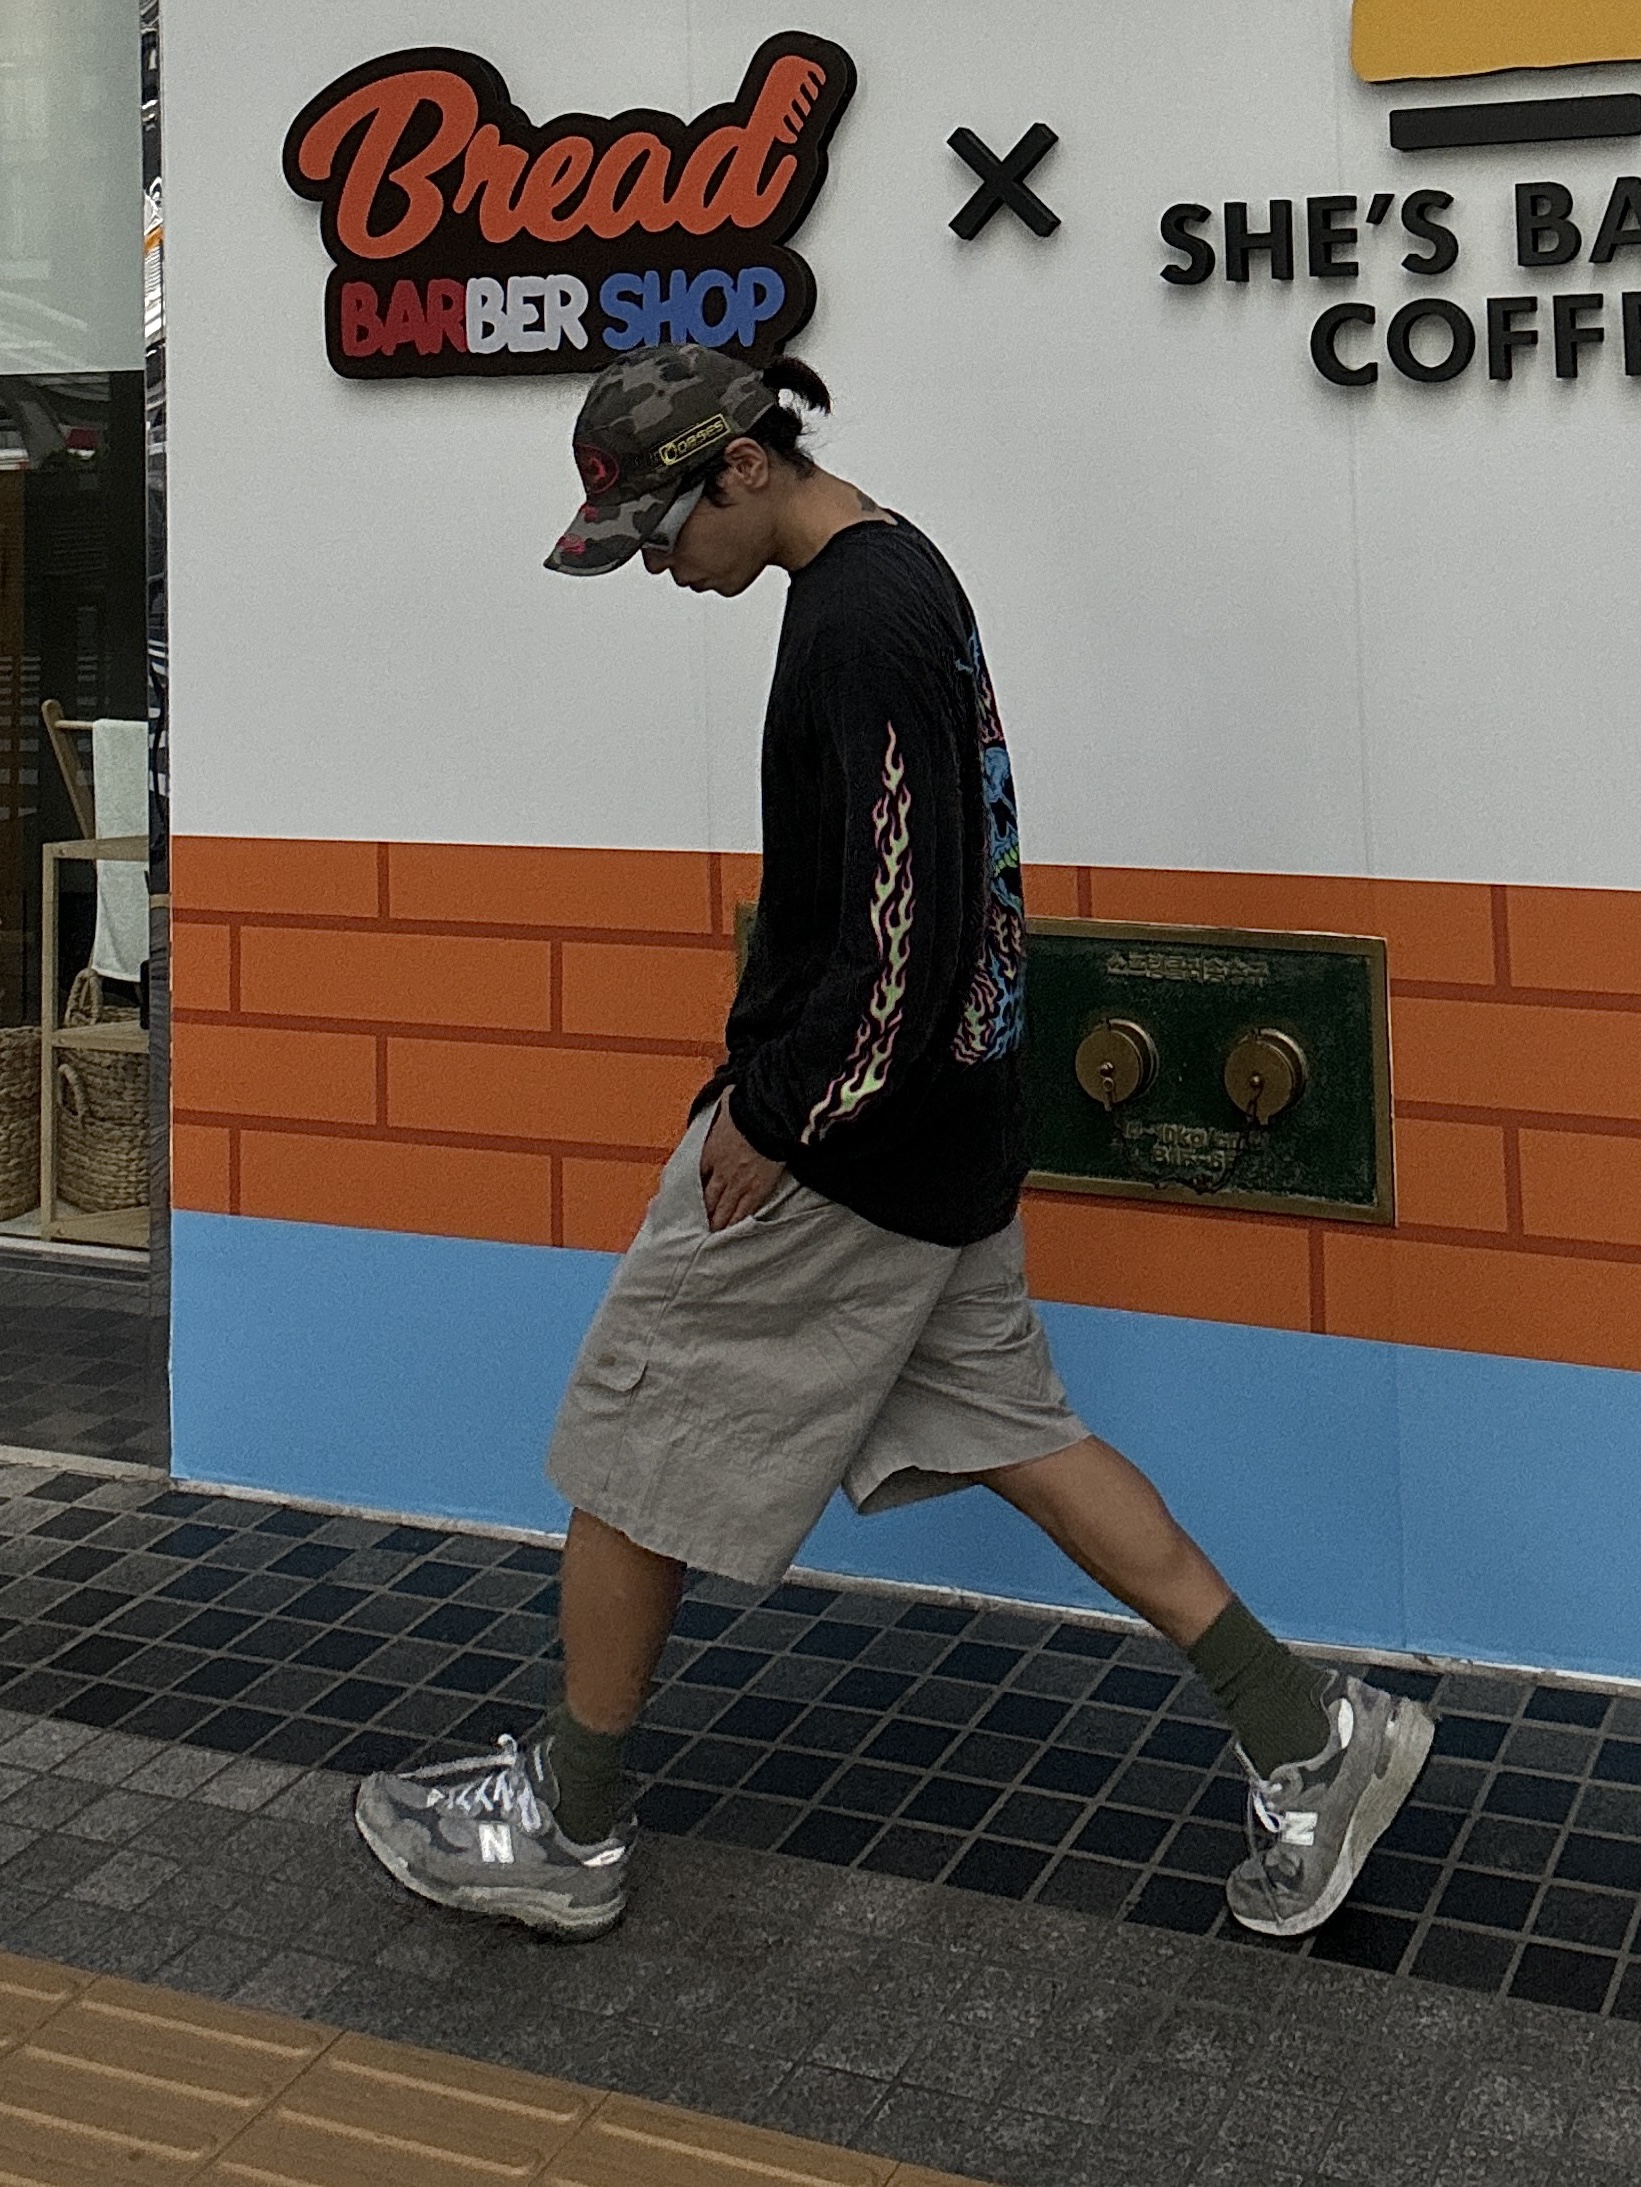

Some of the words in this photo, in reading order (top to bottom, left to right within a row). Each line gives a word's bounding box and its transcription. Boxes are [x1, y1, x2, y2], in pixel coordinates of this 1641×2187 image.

[299, 54, 827, 260] Bread
[1159, 188, 1460, 286] SHE'S
[1514, 175, 1641, 268] BA
[341, 274, 589, 358] BARBER
[599, 266, 786, 351] SHOP
